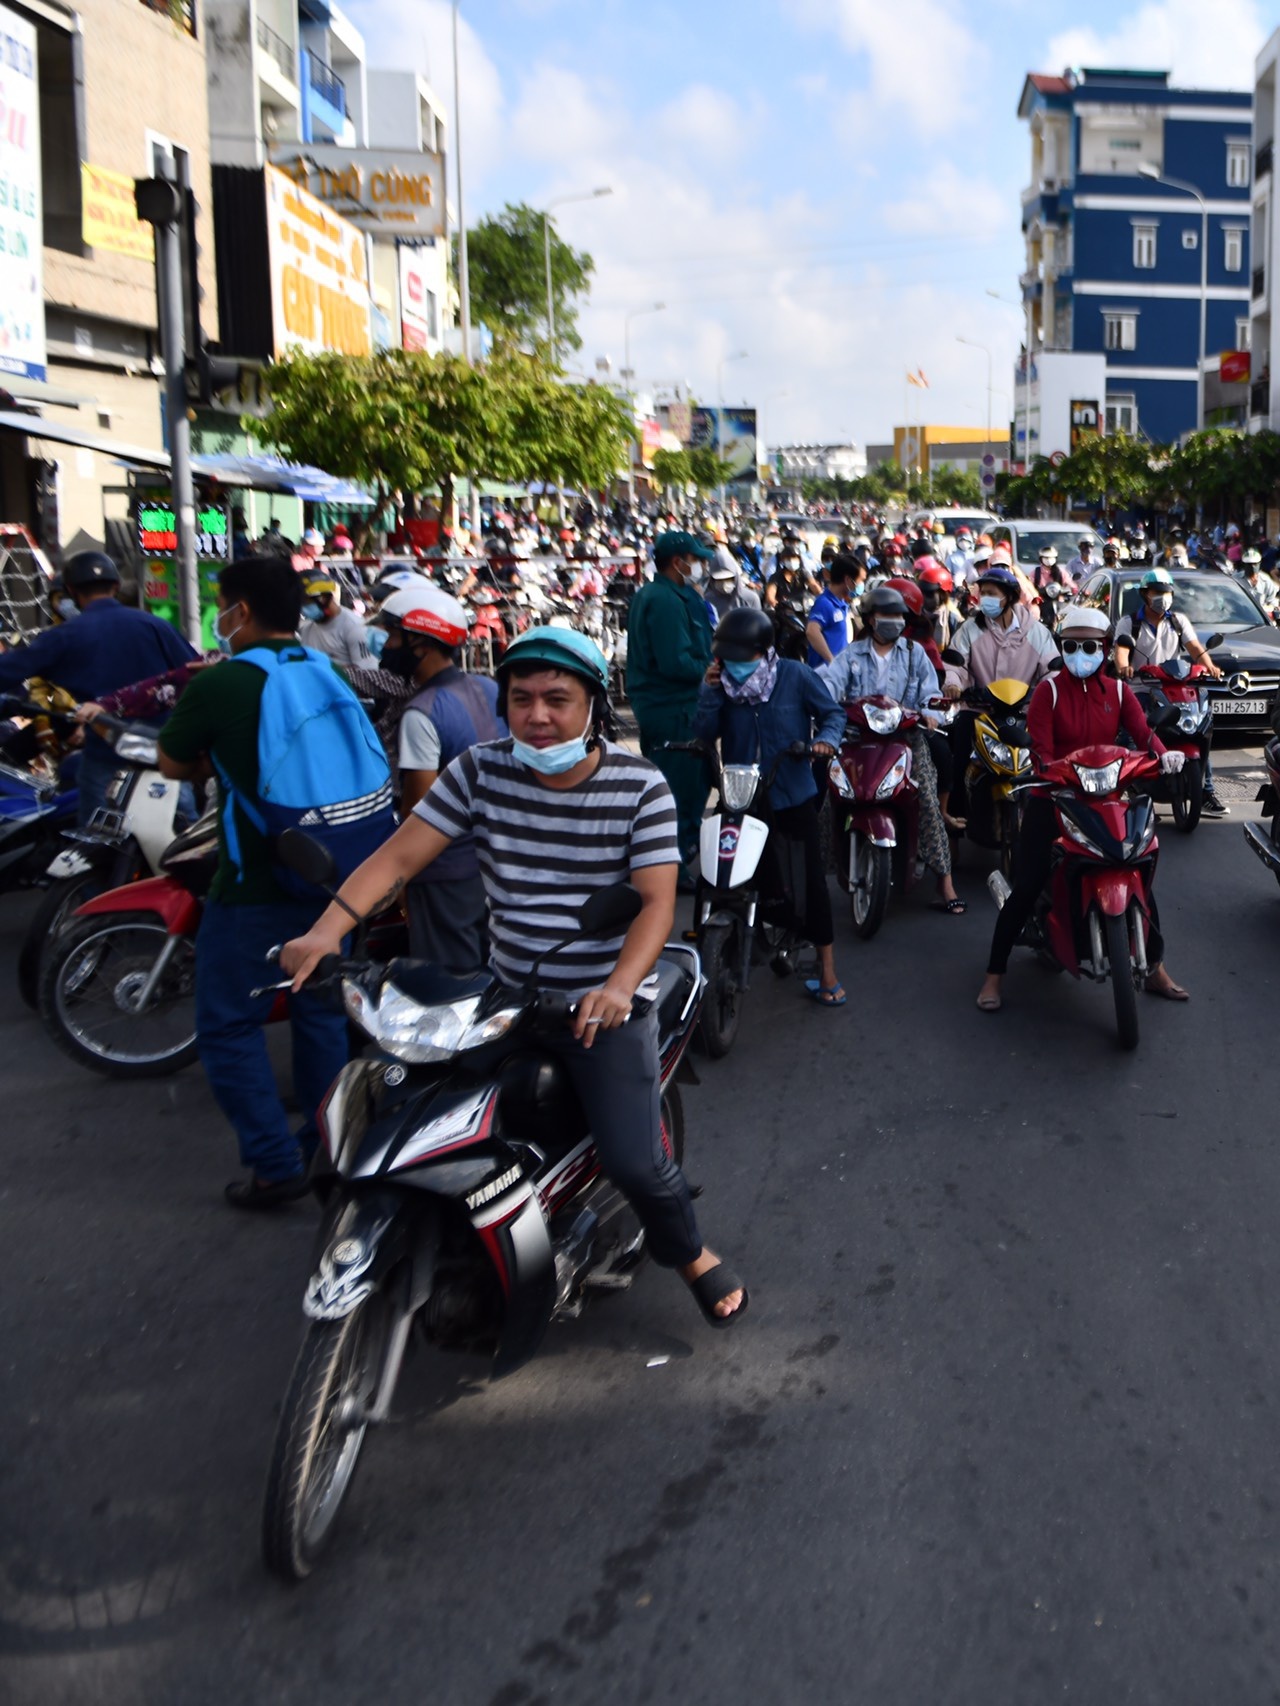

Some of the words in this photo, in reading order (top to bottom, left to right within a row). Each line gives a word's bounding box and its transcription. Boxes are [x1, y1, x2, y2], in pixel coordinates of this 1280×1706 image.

[370, 165, 433, 207] CÚNG
[1213, 702, 1265, 713] 51H-257.13
[465, 1162, 523, 1211] YAMAHA
